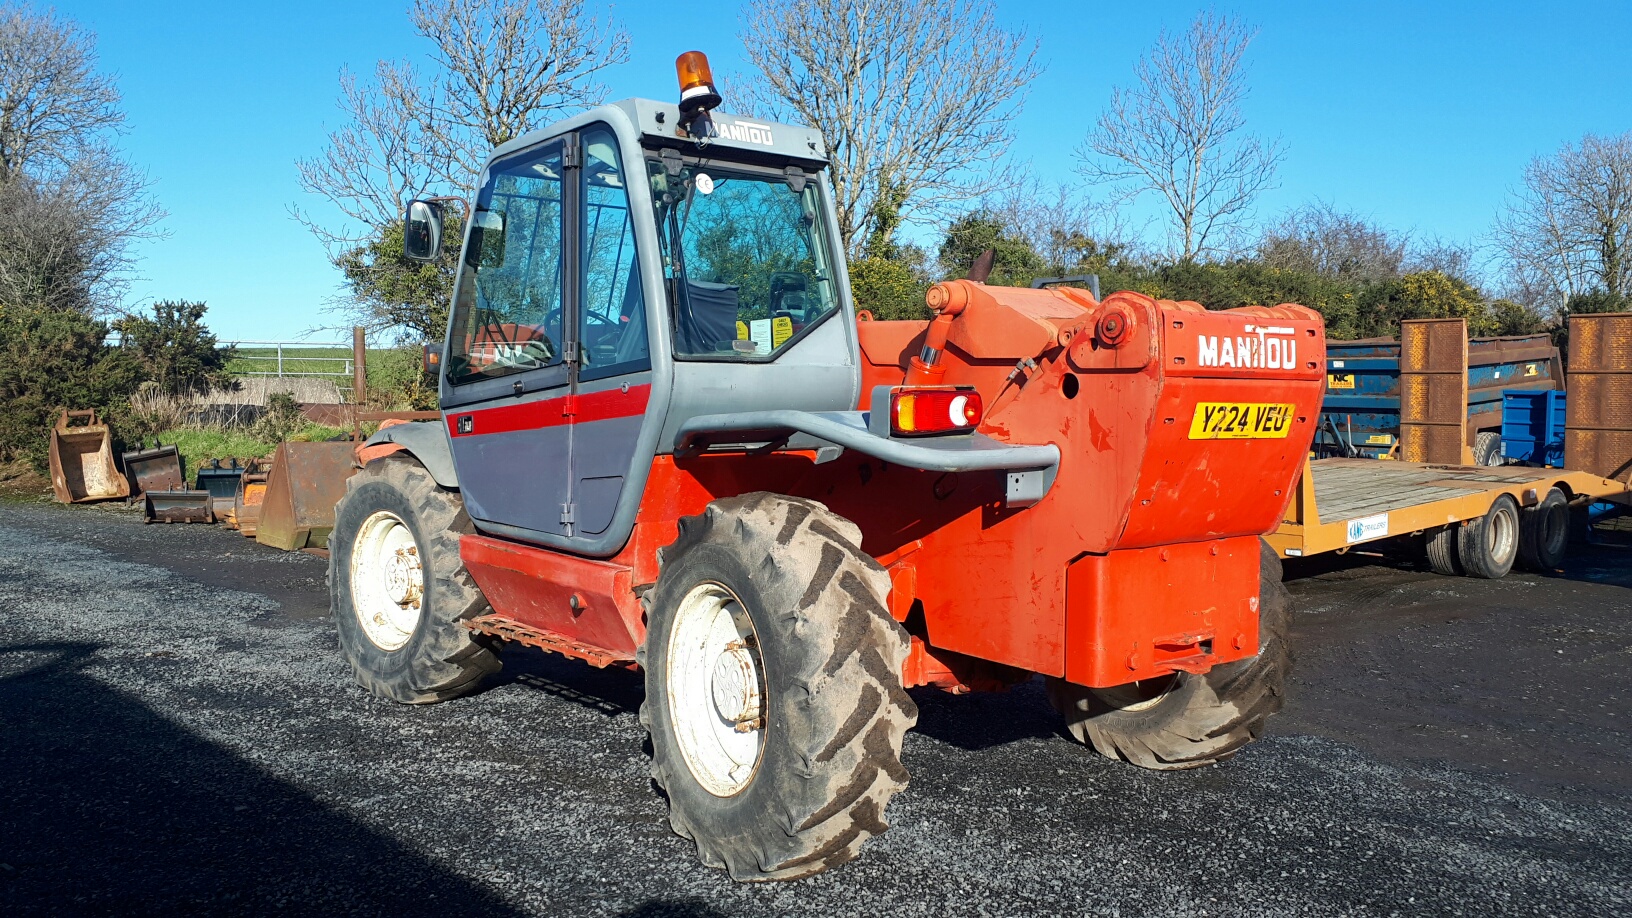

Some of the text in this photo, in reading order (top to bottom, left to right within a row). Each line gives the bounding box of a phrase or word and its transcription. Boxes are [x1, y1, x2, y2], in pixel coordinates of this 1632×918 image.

[704, 120, 774, 146] MANITOU
[1198, 324, 1297, 370] MANITOU
[1333, 374, 1349, 382] NC
[1203, 406, 1289, 433] Y224 VEU
[1364, 521, 1386, 532] TRAILERS
